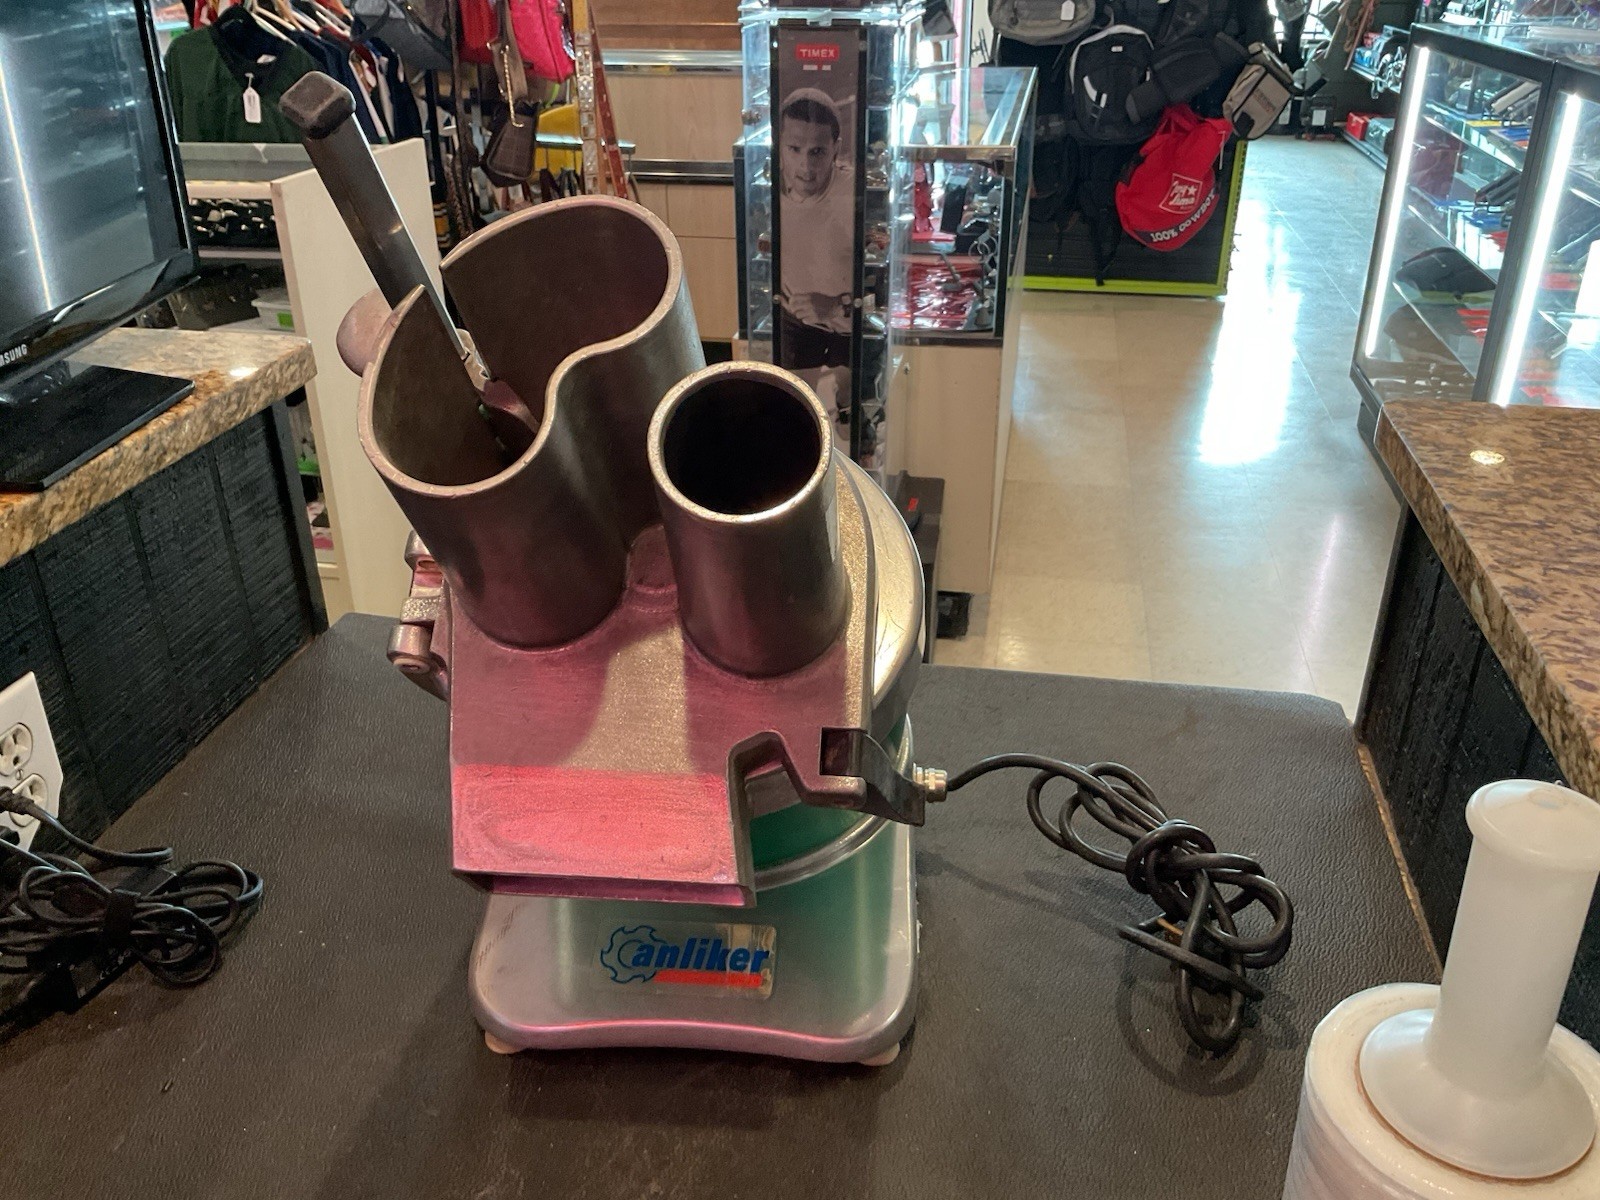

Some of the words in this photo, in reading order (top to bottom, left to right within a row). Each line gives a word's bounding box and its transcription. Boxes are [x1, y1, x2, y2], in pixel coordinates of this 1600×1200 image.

[800, 48, 835, 58] TIMEX
[1150, 228, 1178, 242] 100%
[631, 937, 769, 973] anliker
